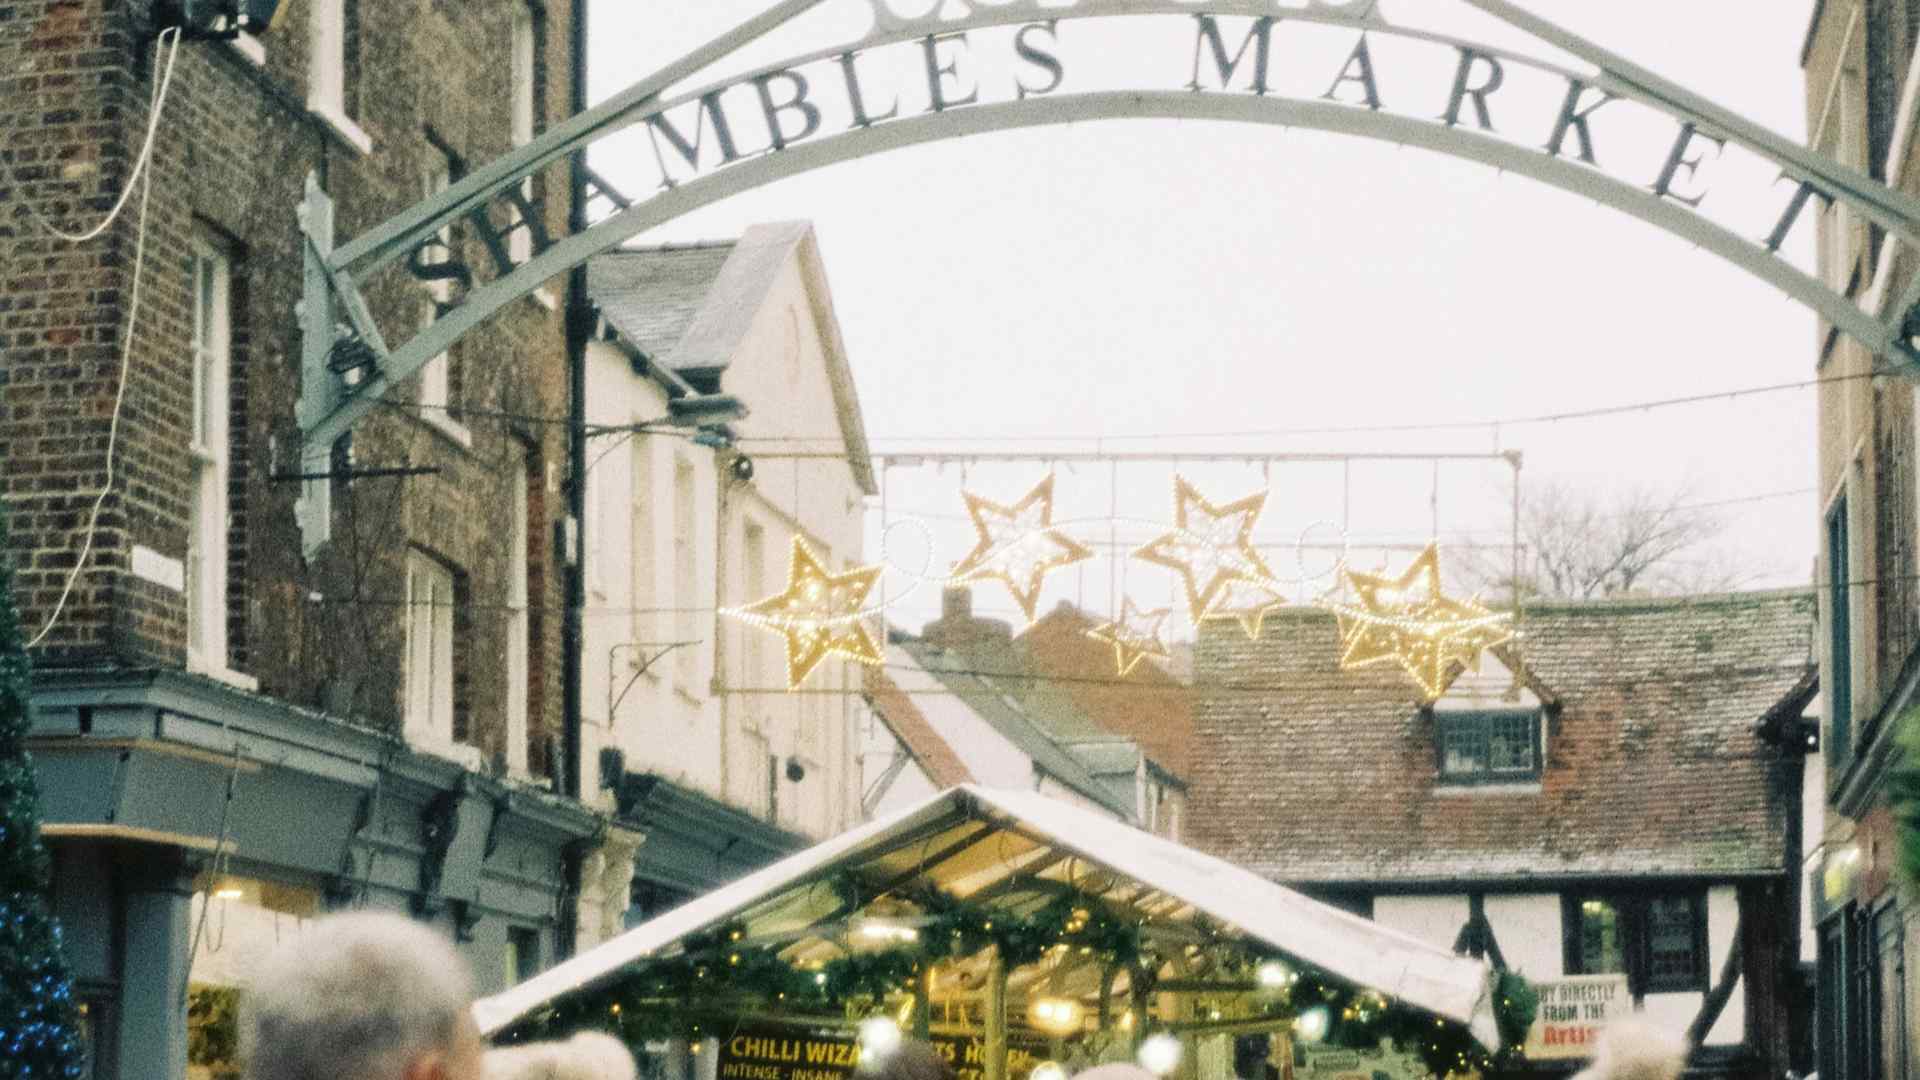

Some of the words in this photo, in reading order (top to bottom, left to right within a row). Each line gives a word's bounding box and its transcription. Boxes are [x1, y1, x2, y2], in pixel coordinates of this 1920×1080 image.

[407, 18, 1066, 292] SHAMBLES
[1184, 13, 1836, 254] MARKET
[1560, 983, 1616, 1001] DIRECTLY
[1543, 1004, 1578, 1021] FROM
[1584, 1002, 1606, 1019] THE
[730, 1035, 801, 1062] CHILLI
[805, 1040, 864, 1068] WIZA
[722, 1063, 781, 1080] INTENSE
